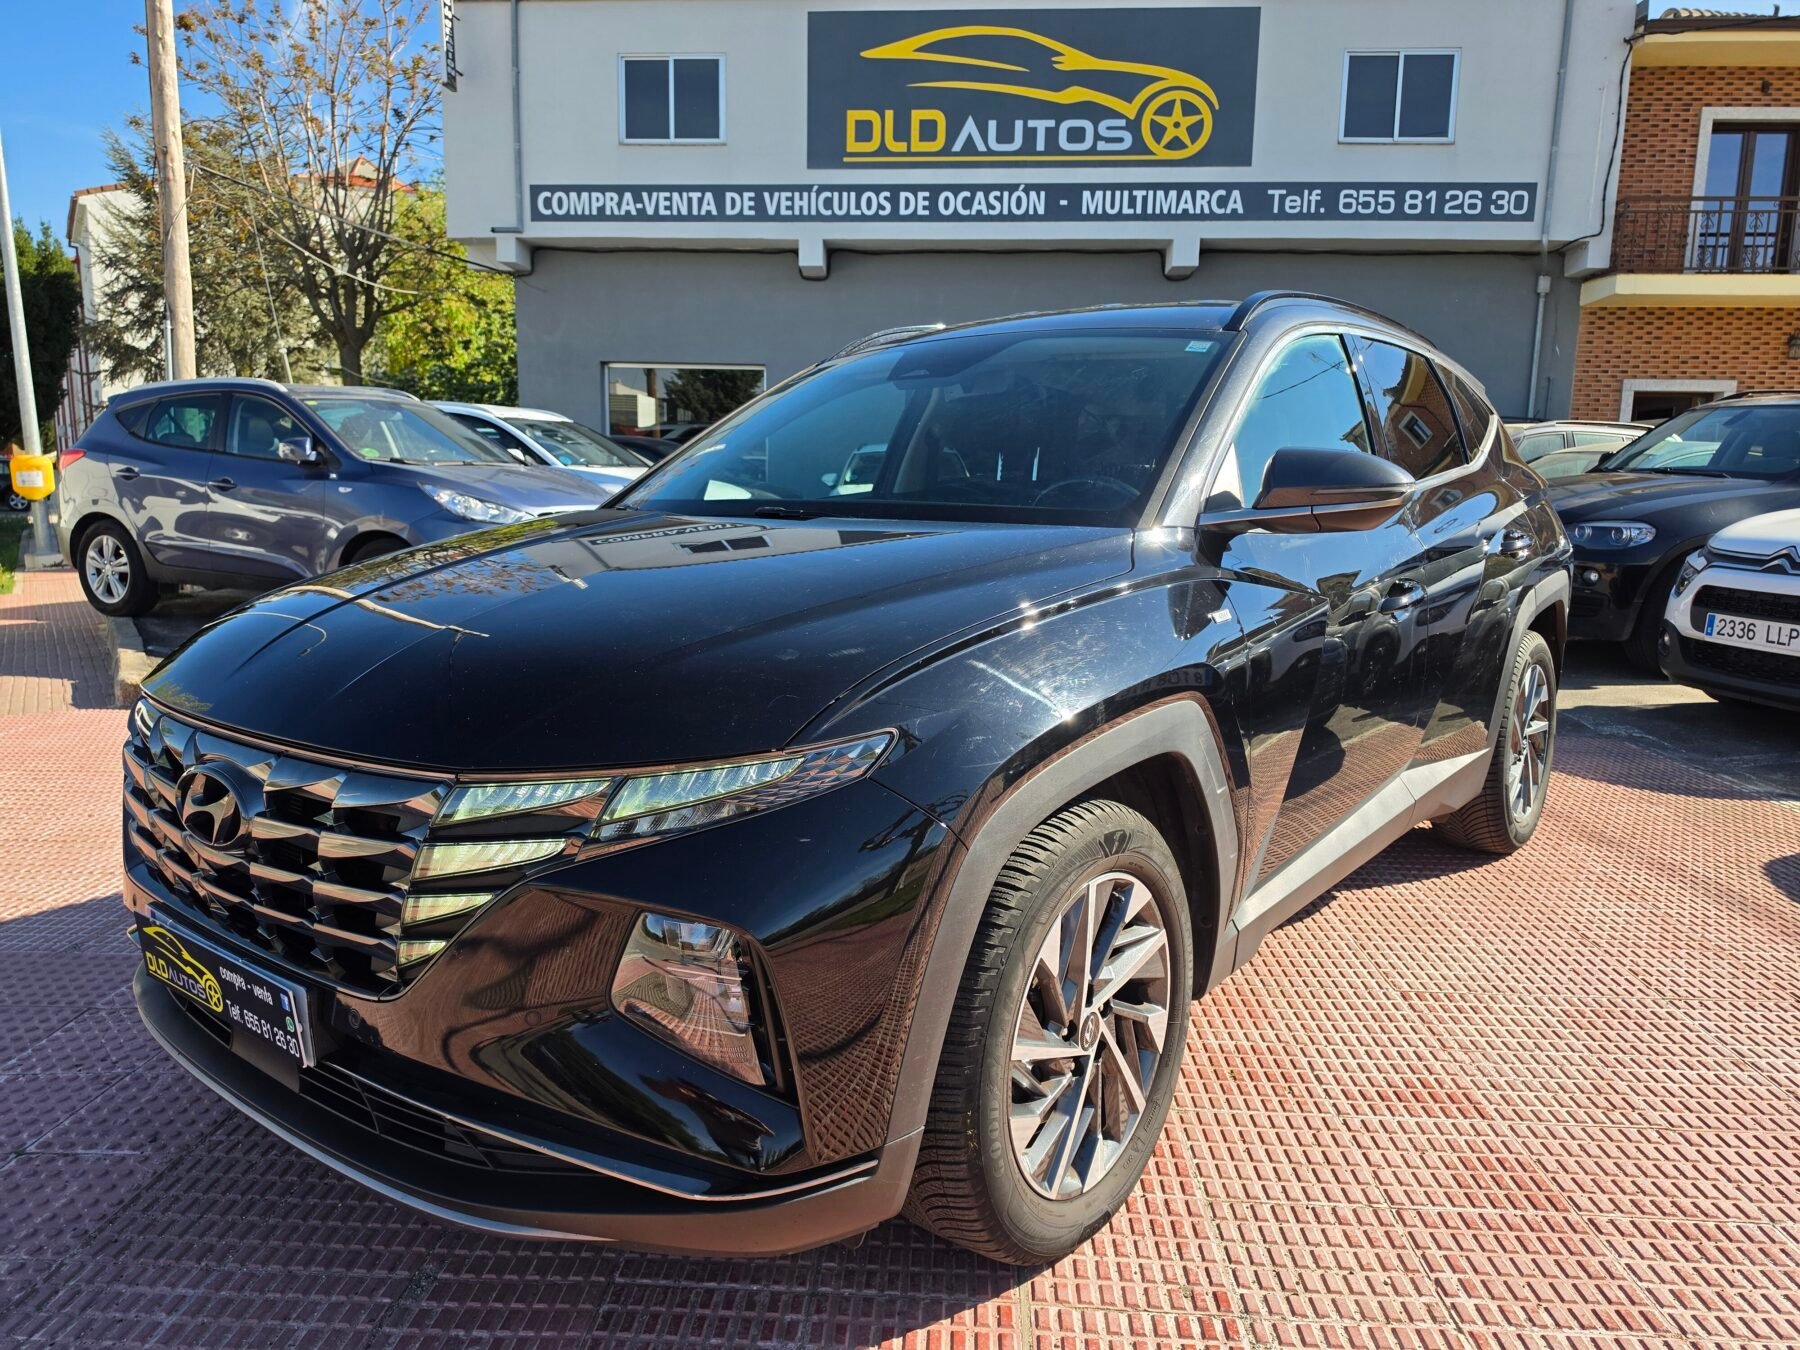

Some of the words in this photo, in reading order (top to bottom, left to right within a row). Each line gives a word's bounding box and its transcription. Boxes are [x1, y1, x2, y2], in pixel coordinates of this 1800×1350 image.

[846, 109, 946, 152] DLD
[951, 115, 1133, 151] AUTOS
[537, 190, 717, 216] COMPRA-VENTA
[726, 191, 755, 216] DE
[763, 186, 891, 216] VEHÍCULOS
[900, 191, 930, 216] DE
[937, 186, 1046, 216] OCASIÓN
[1082, 190, 1244, 215] MULTIMARCA
[1268, 189, 1325, 214] Telf.
[1338, 189, 1396, 215] 655
[1403, 189, 1437, 215] 81
[1443, 190, 1483, 215] 26
[1490, 190, 1529, 215] 30
[1717, 618, 1757, 641] 2336
[1765, 625, 1800, 646] LLP
[145, 951, 169, 979] DLD
[168, 966, 207, 999] AUTOS
[219, 966, 246, 991] compra
[252, 983, 274, 1006] venta
[243, 1009, 262, 1034] 655
[260, 1019, 274, 1041] 81
[273, 1027, 287, 1050] 26
[286, 1035, 300, 1058] 30
